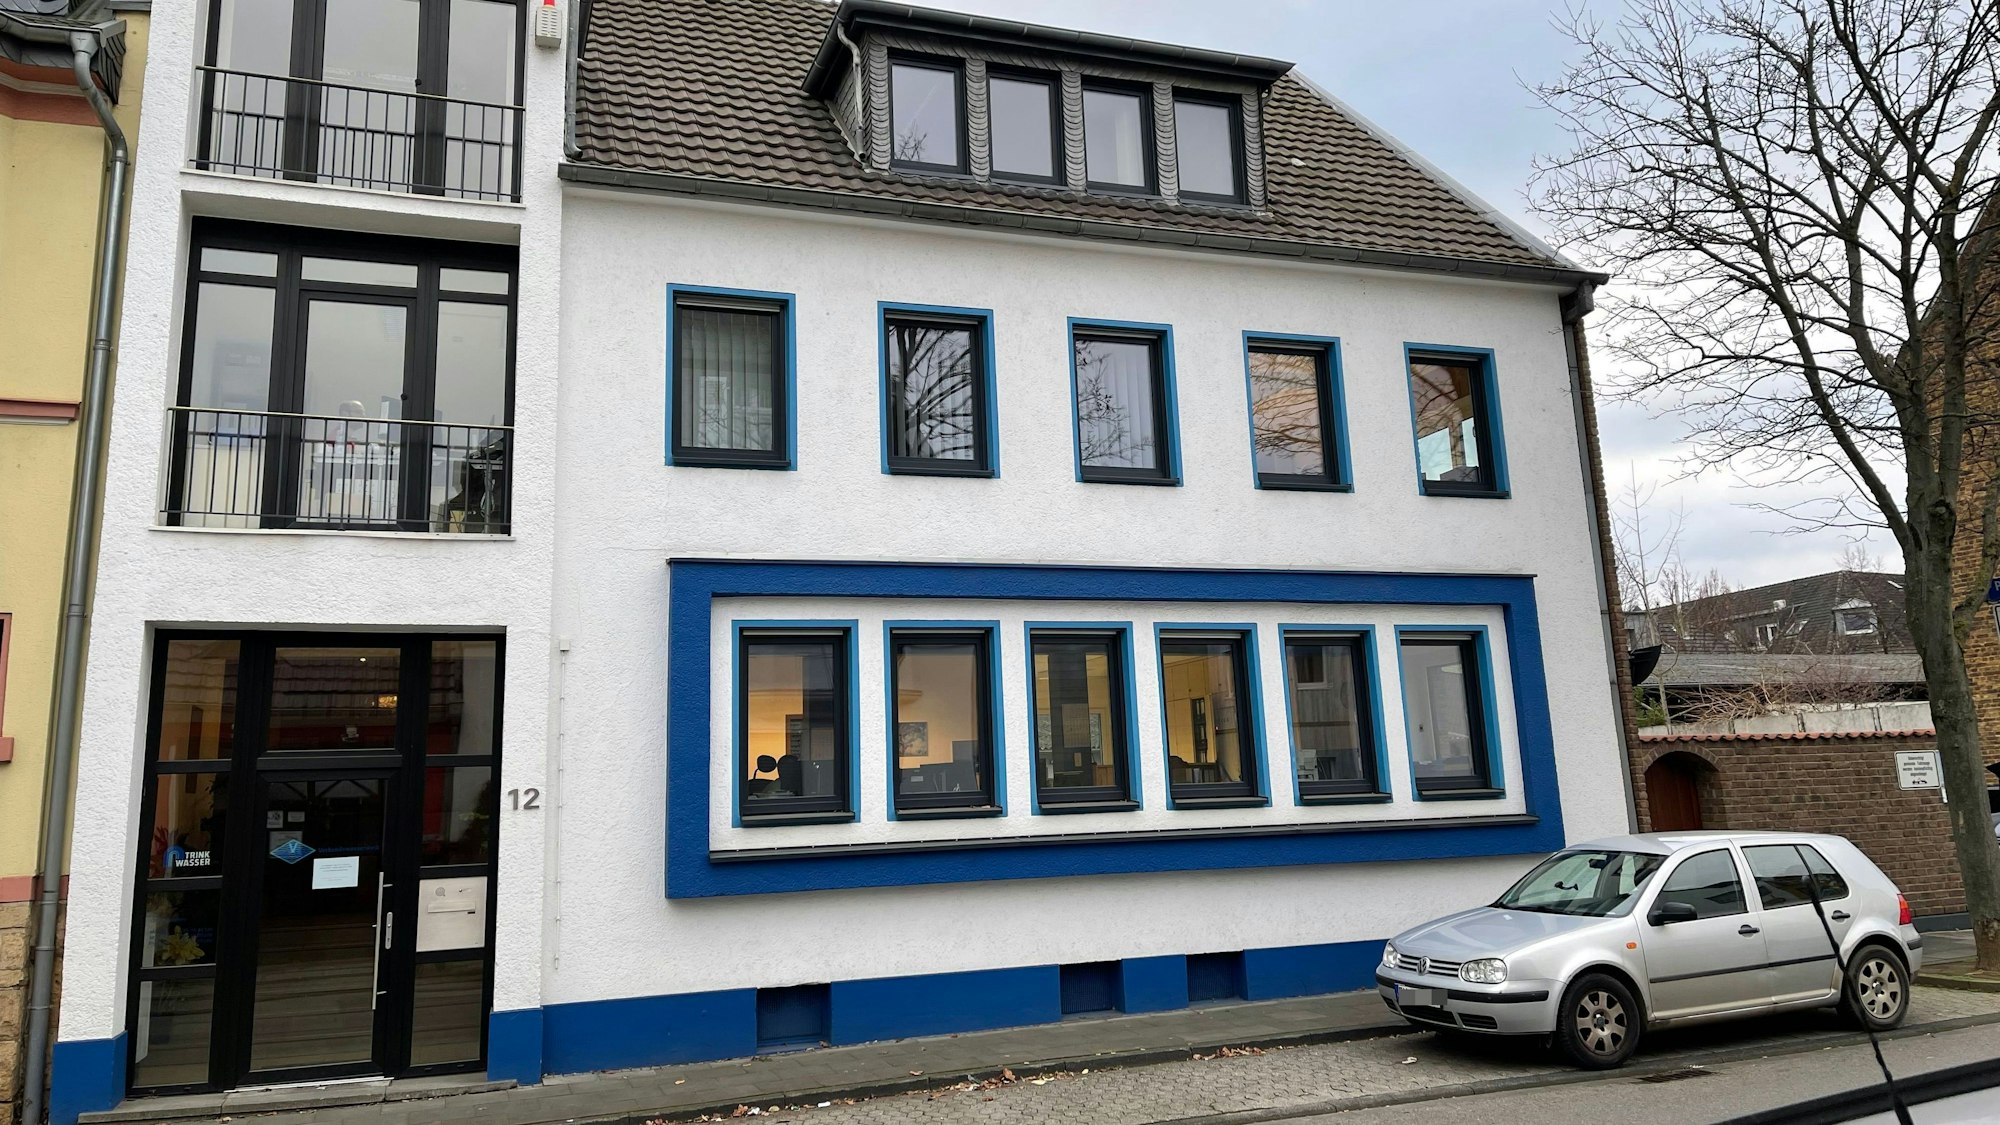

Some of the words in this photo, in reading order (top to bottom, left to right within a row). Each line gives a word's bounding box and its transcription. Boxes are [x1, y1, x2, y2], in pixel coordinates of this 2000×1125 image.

[508, 788, 540, 811] 12
[184, 851, 211, 859] TRINK
[175, 858, 211, 867] WASSER
